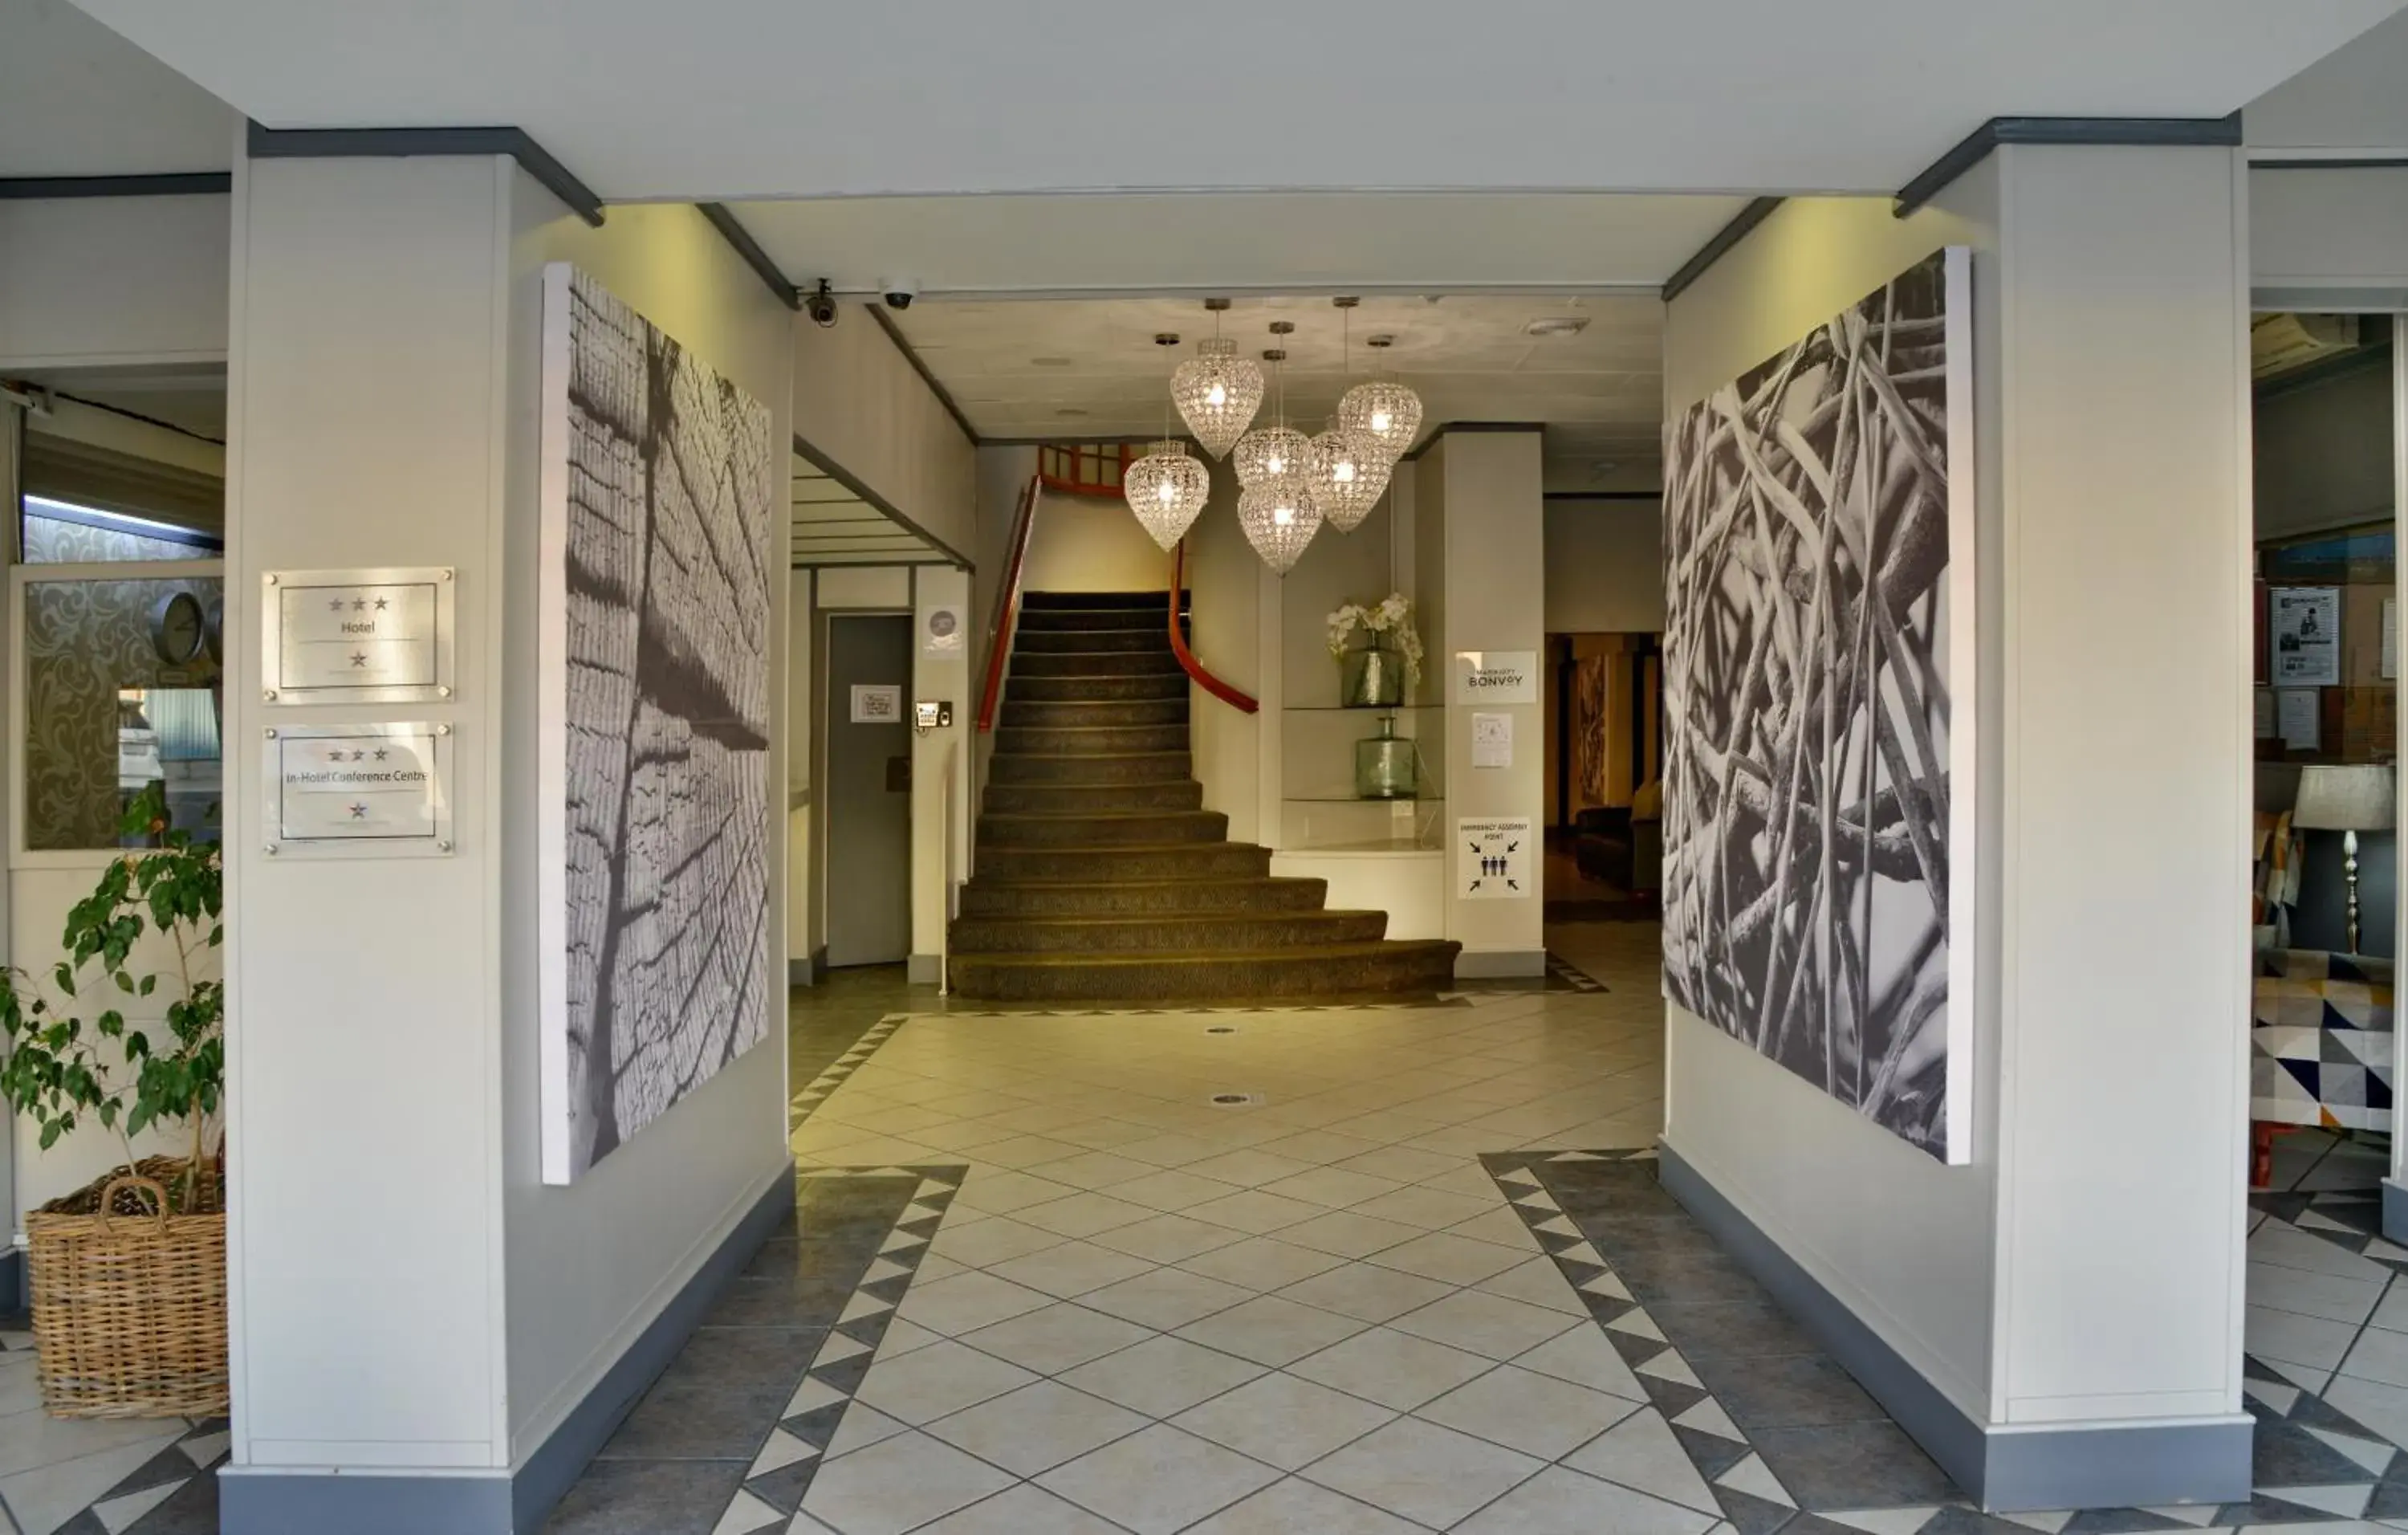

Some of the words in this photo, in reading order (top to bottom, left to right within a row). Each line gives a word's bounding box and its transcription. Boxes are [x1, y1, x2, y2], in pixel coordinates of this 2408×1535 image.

[341, 621, 376, 633] Hotel
[1469, 675, 1523, 687] BONVOY
[287, 771, 330, 784] In-Hotel
[332, 770, 391, 783] Conference
[393, 770, 428, 782] Centre
